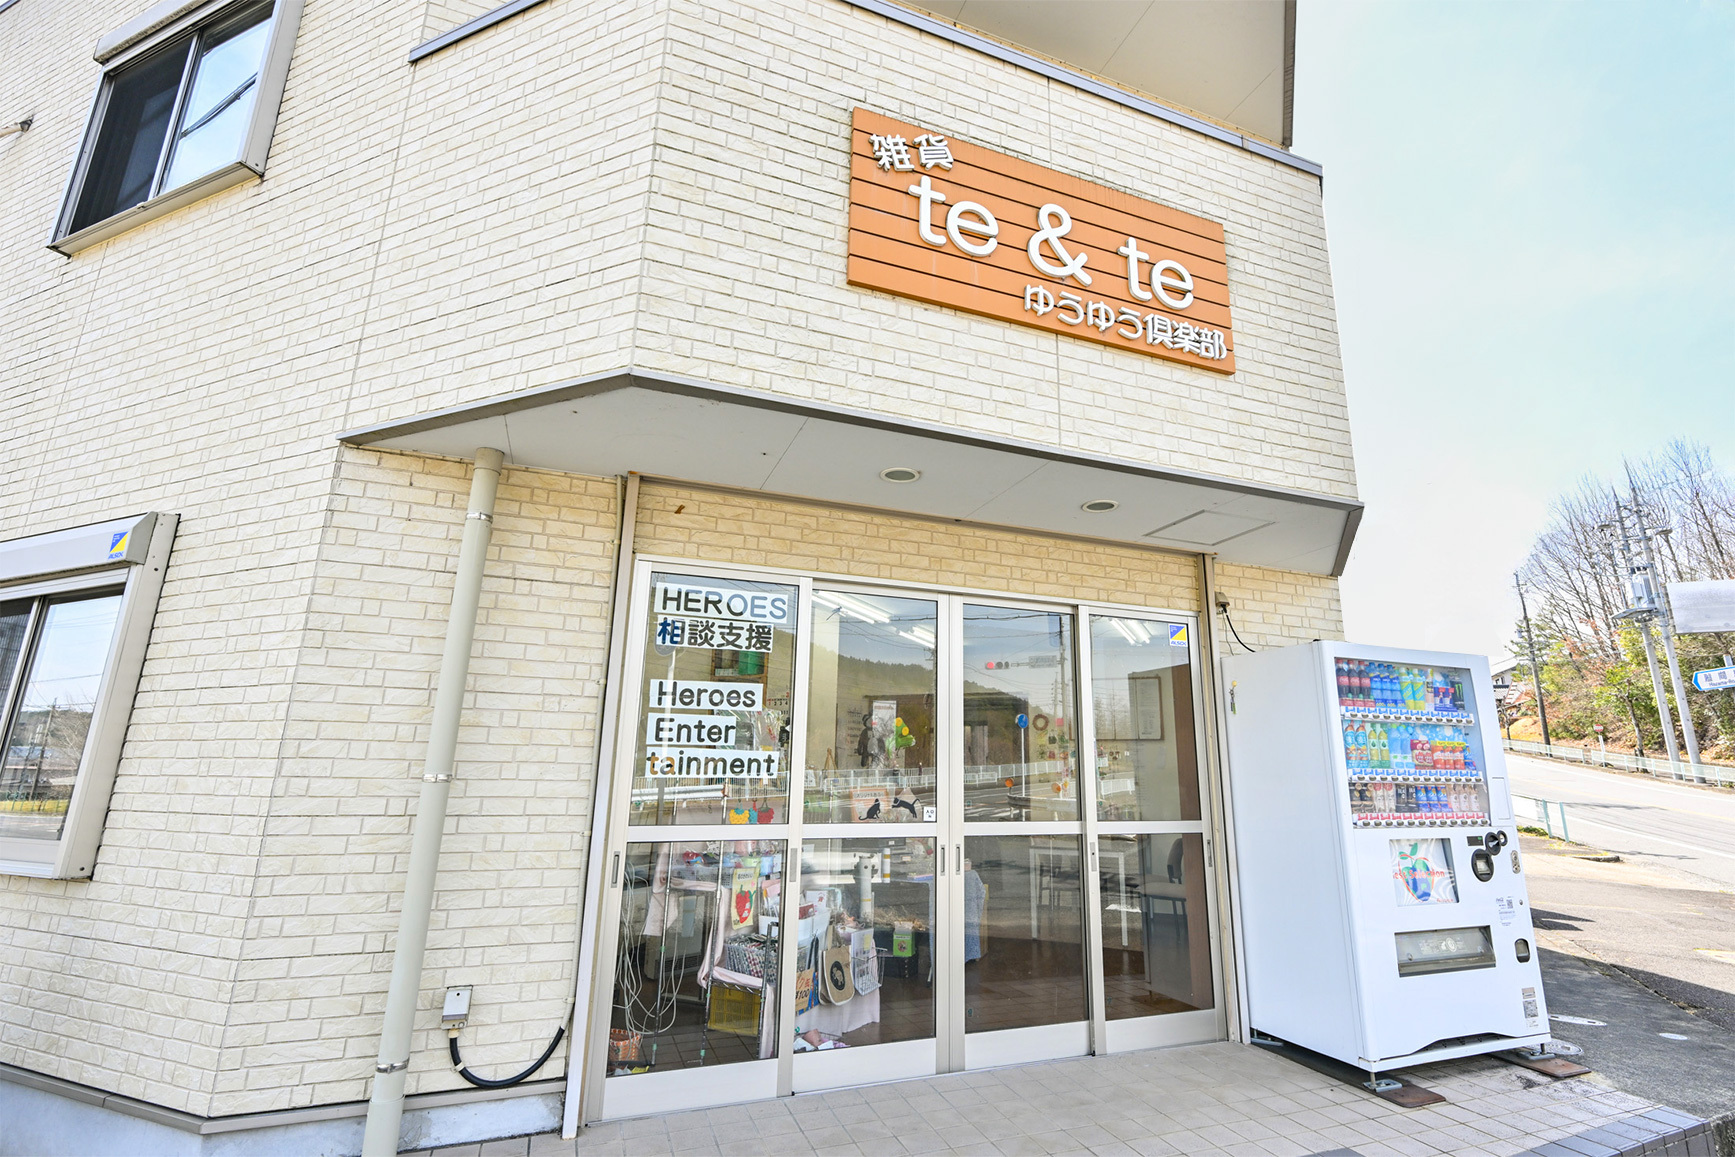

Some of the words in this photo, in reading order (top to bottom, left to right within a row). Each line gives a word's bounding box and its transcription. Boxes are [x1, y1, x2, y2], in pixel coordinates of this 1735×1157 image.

[868, 133, 954, 172] 雑貨
[908, 175, 999, 258] te
[1027, 203, 1093, 287] &
[1117, 236, 1195, 310] te
[1023, 283, 1228, 361] ゆうゆう倶楽部
[662, 586, 787, 620] HEROES
[657, 616, 772, 651] 相談支援
[657, 680, 756, 707] Heroes
[655, 718, 736, 743] Enter
[646, 750, 775, 776] tainment
